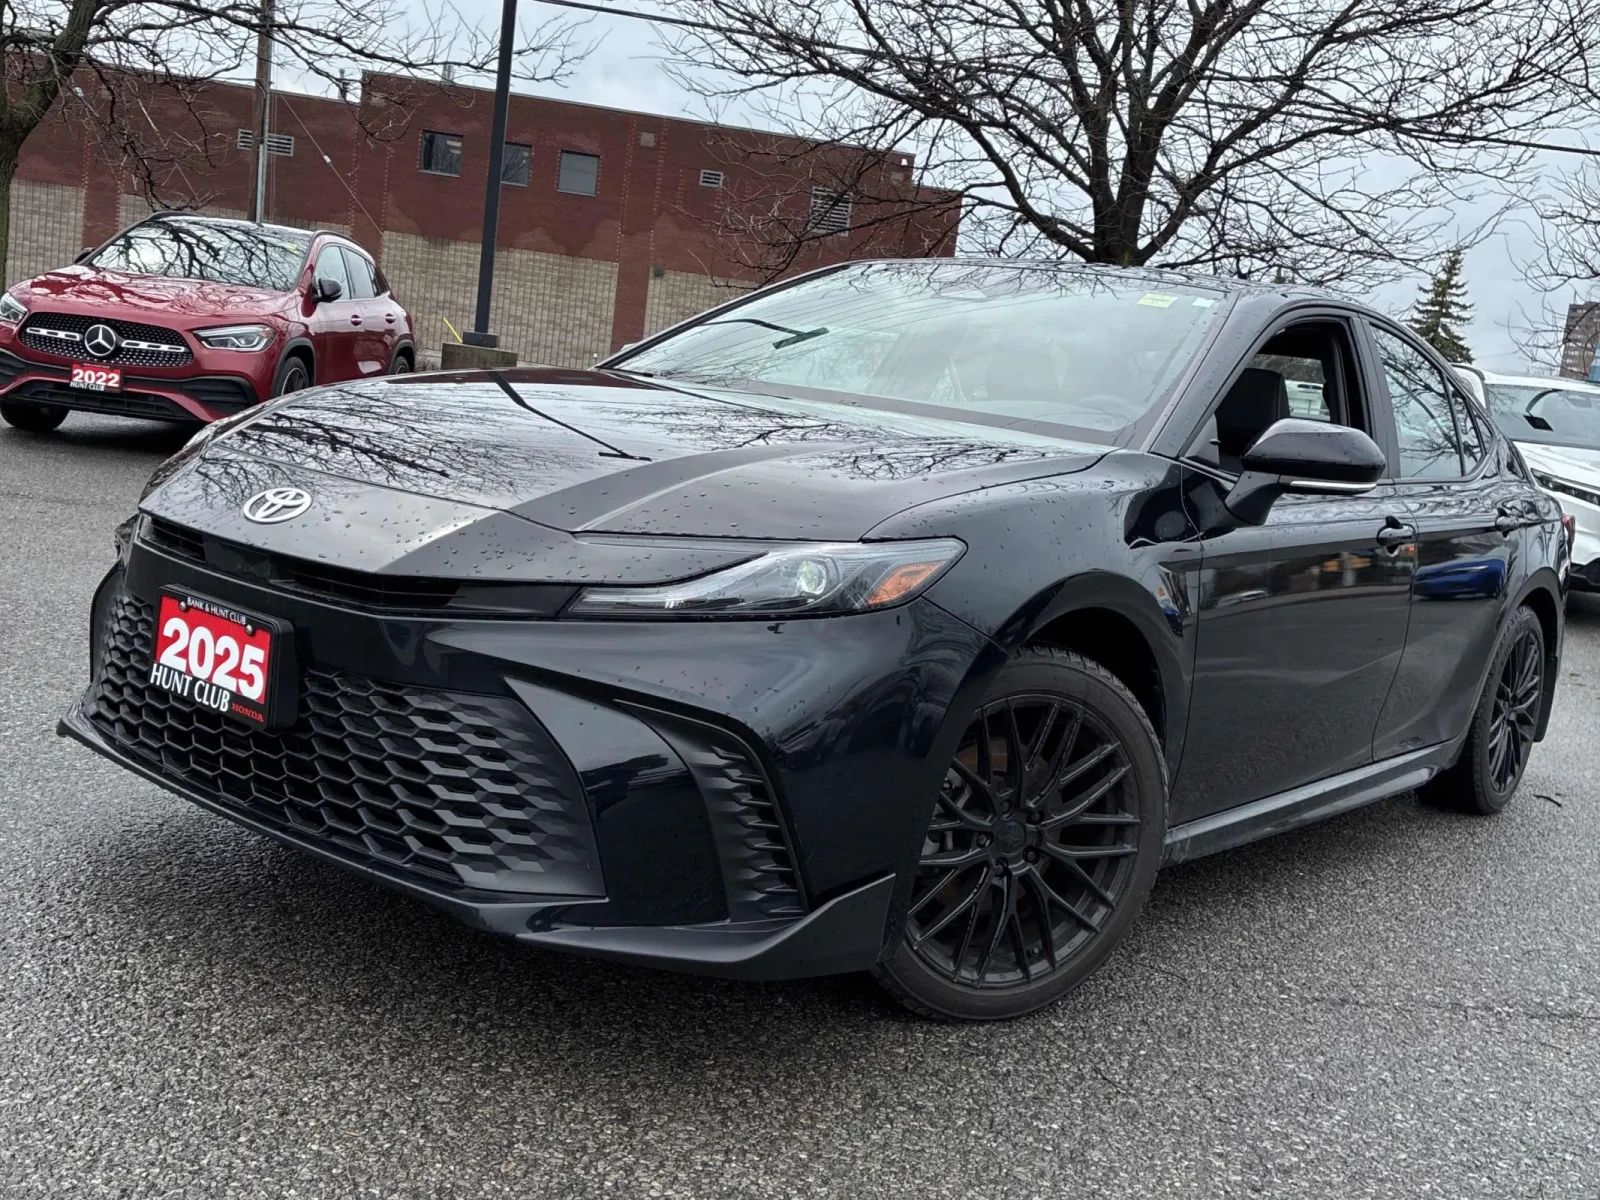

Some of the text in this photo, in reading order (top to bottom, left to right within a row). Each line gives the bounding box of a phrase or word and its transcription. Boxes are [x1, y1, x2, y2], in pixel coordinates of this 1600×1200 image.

[70, 381, 88, 389] HUNT
[72, 369, 119, 387] 2022
[187, 597, 247, 625] BANK & HUNT CLUB
[159, 617, 265, 701] 2025
[150, 663, 231, 713] HUNT CLUB
[231, 702, 264, 723] HONDA
